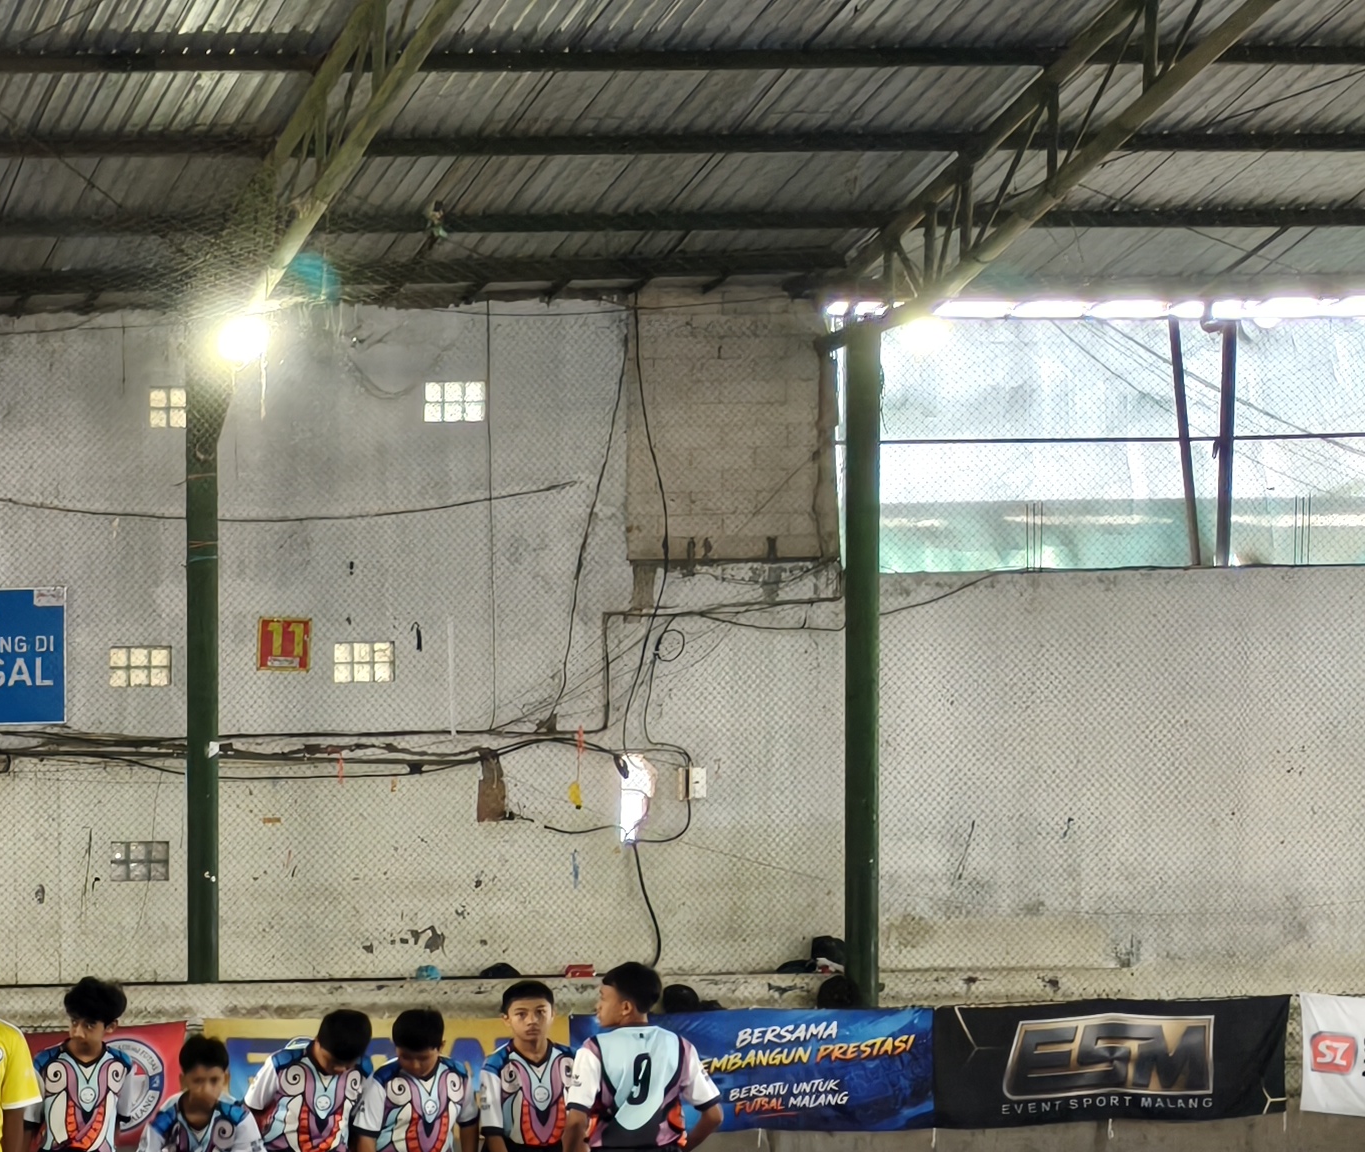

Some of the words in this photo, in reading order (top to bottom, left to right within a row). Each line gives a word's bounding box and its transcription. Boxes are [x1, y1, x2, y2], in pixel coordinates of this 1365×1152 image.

[35, 635, 54, 652] DI
[267, 622, 304, 657] 11
[736, 1020, 838, 1048] BERSAMA
[701, 1046, 812, 1074] EMBANGUN
[816, 1034, 915, 1063] PRESTASI
[627, 1053, 651, 1105] 9
[729, 1081, 789, 1101] BERSATU
[793, 1079, 842, 1095] UNTUK
[735, 1098, 785, 1116] FUTSAL
[788, 1092, 849, 1108] MALANG
[1002, 1101, 1062, 1114] EVENT
[1069, 1096, 1133, 1109] SPORT
[1140, 1097, 1213, 1109] MALANG
